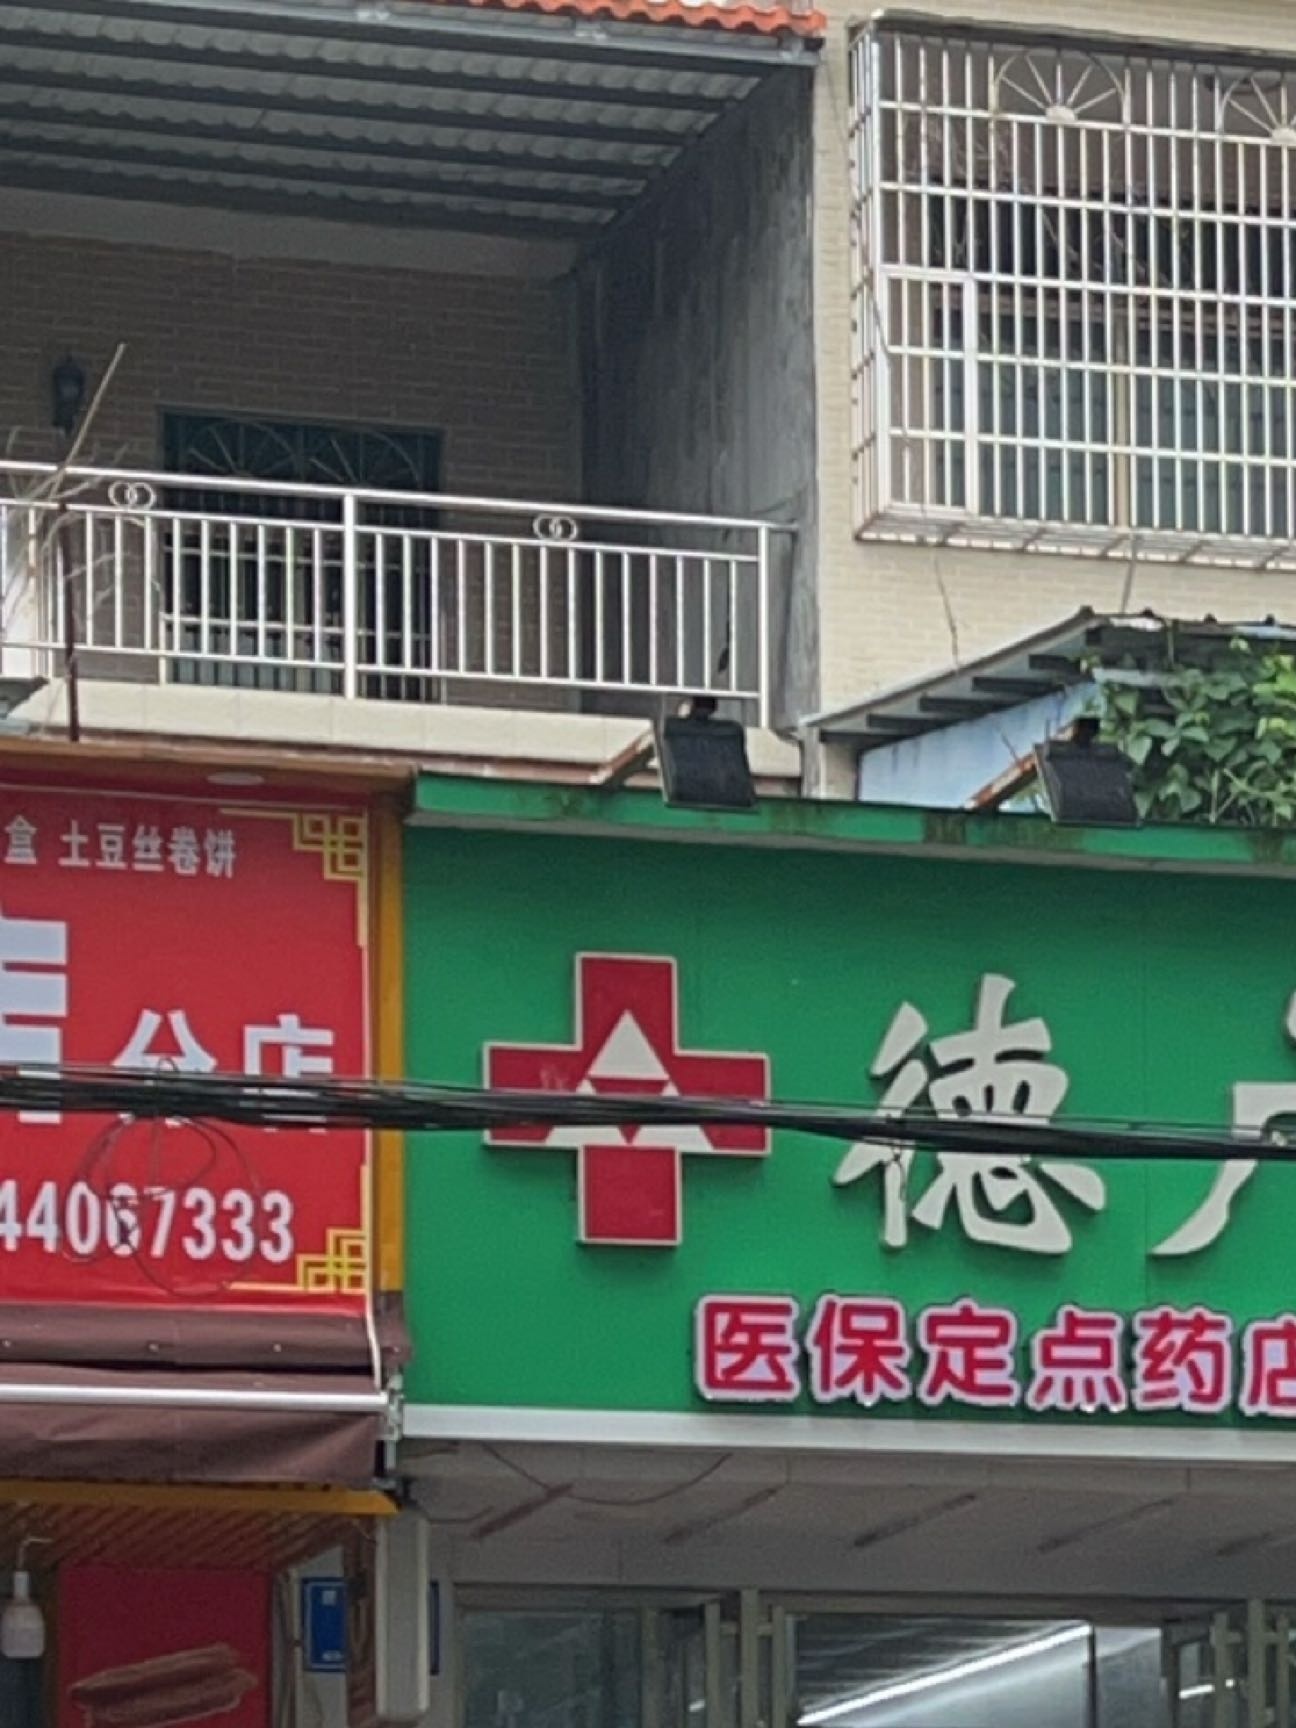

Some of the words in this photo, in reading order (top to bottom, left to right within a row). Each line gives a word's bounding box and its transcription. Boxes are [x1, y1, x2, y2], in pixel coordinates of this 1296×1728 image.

[4, 815, 37, 866] 盒
[60, 819, 237, 879] 土豆丝卷饼
[110, 1007, 335, 1132] 分店
